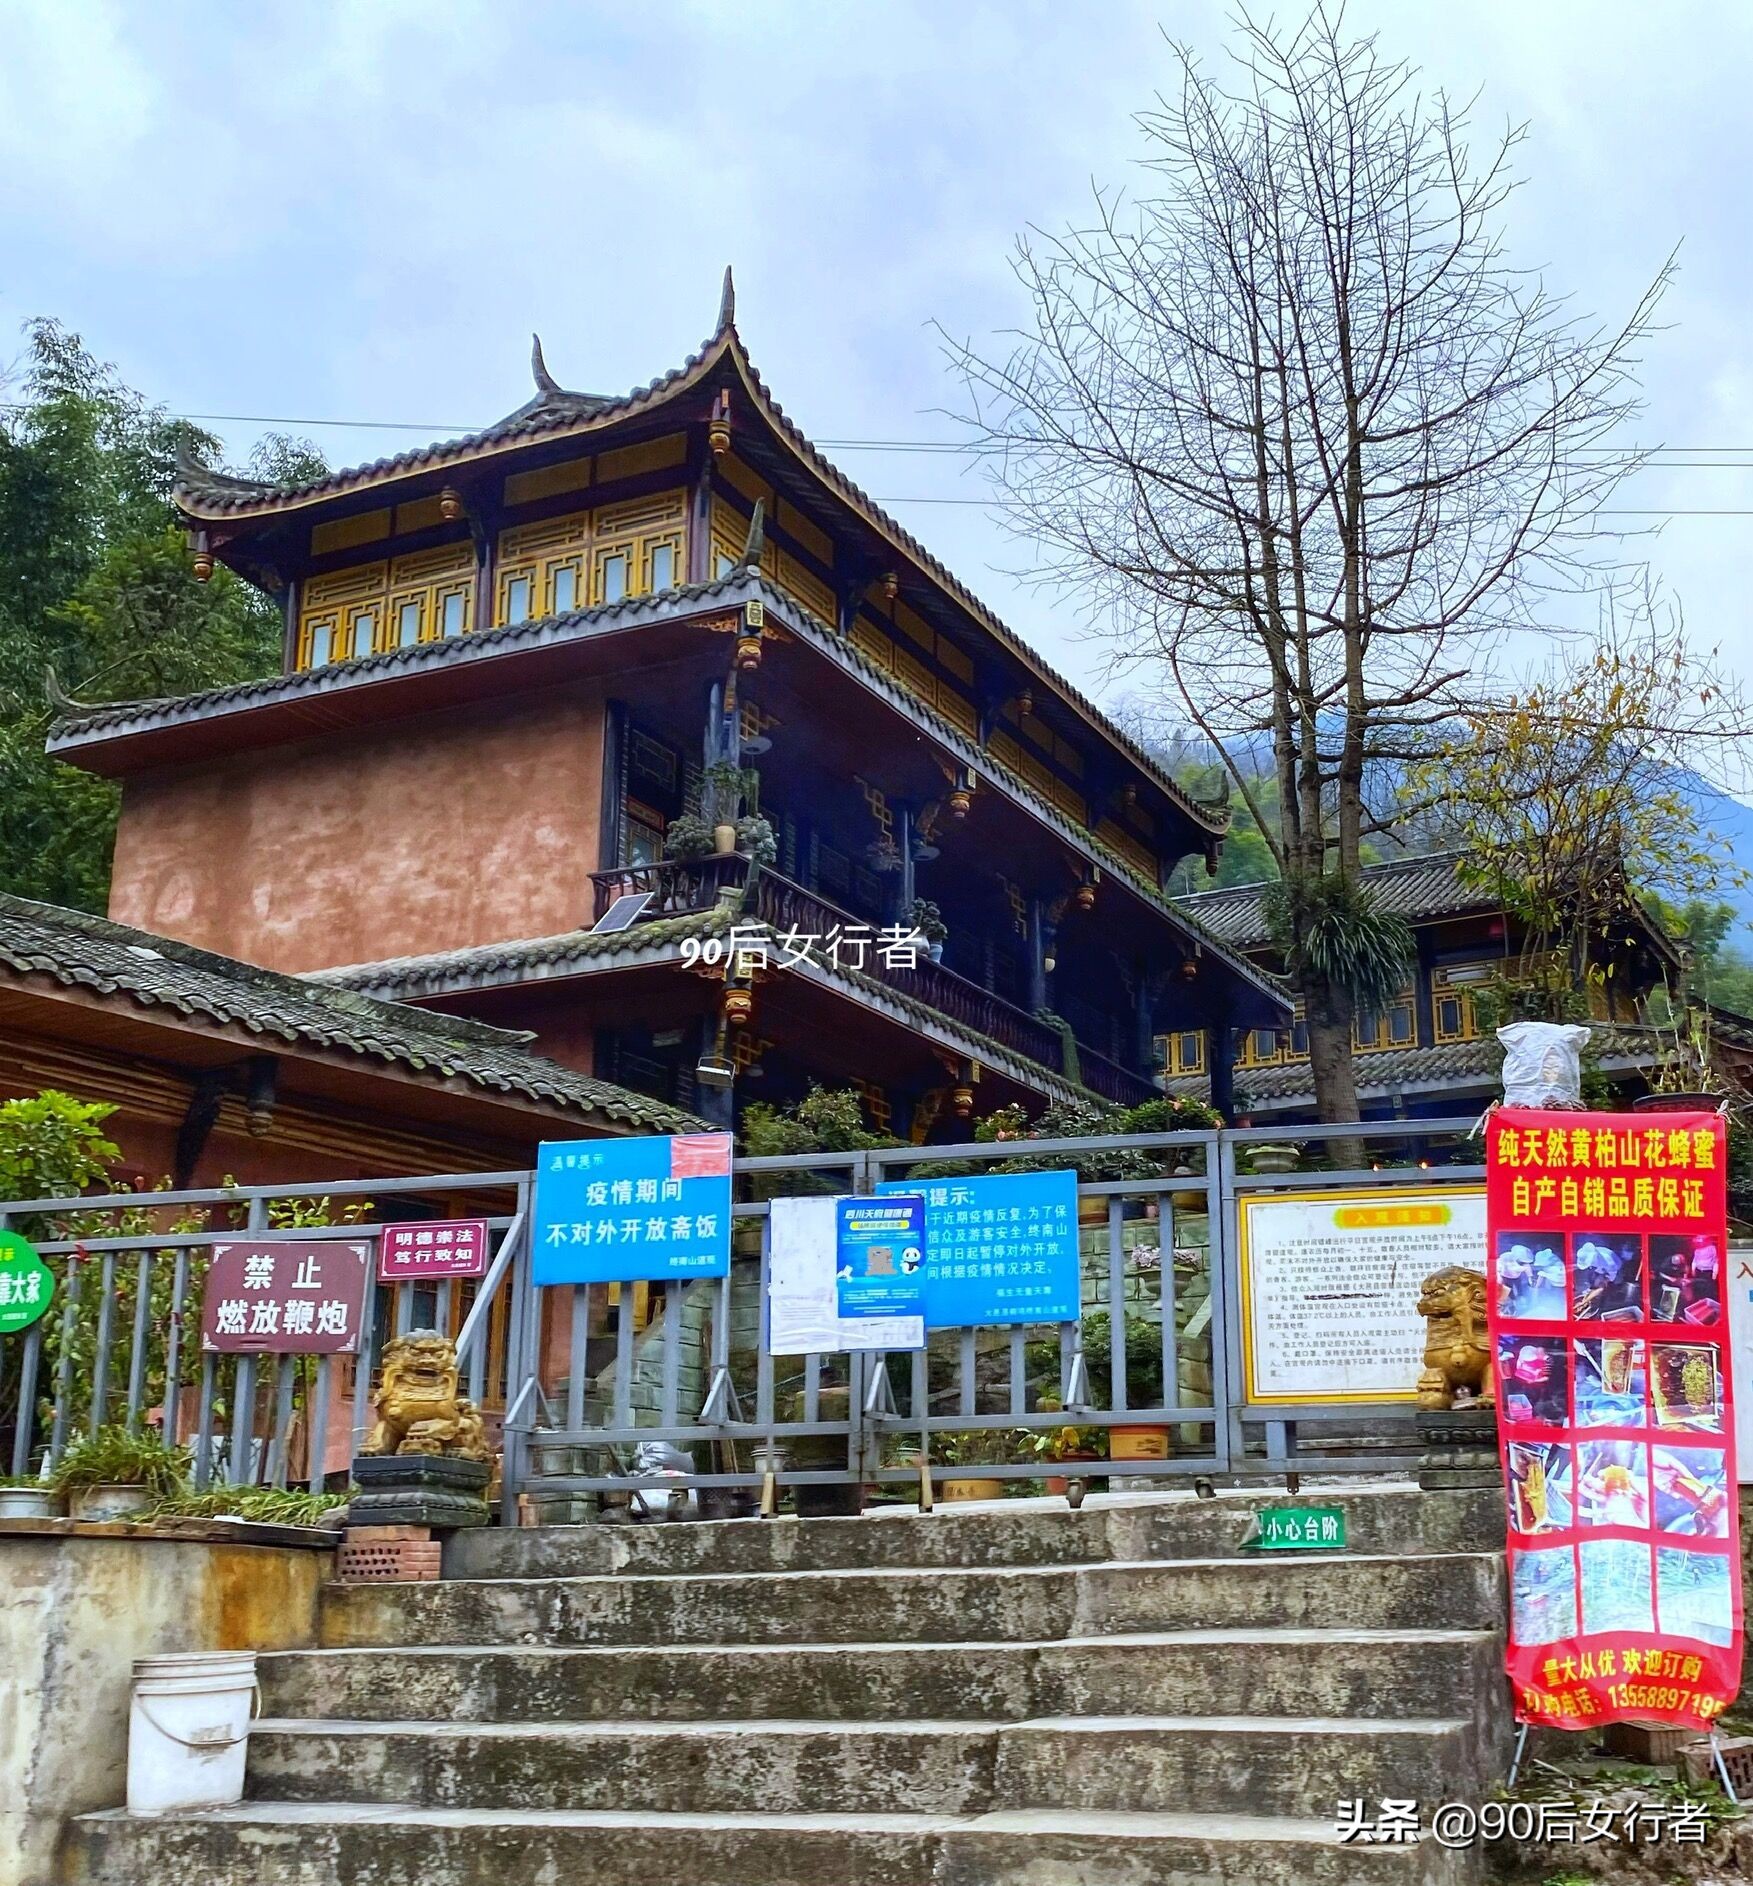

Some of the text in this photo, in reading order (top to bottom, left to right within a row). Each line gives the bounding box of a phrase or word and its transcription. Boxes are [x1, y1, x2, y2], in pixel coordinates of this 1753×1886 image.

[1498, 1128, 1716, 1169] 纯天然黄柏山花蜂蜜
[586, 1177, 682, 1206] 疫情期间
[889, 1186, 975, 1207] 提示:
[1512, 1176, 1705, 1217] 自产自销品质保证
[545, 1214, 718, 1248] 不对外开放斋饭
[925, 1204, 1068, 1227] 于近期疫情反复,为了保
[395, 1229, 474, 1246] 明德崇法
[394, 1248, 473, 1264] 笃行致知
[243, 1254, 322, 1290] 禁止
[215, 1299, 348, 1335] 燃放鞭炮
[1267, 1516, 1338, 1542] 小心台阶
[1543, 1648, 1703, 1687] 量大从优 欢迎订购
